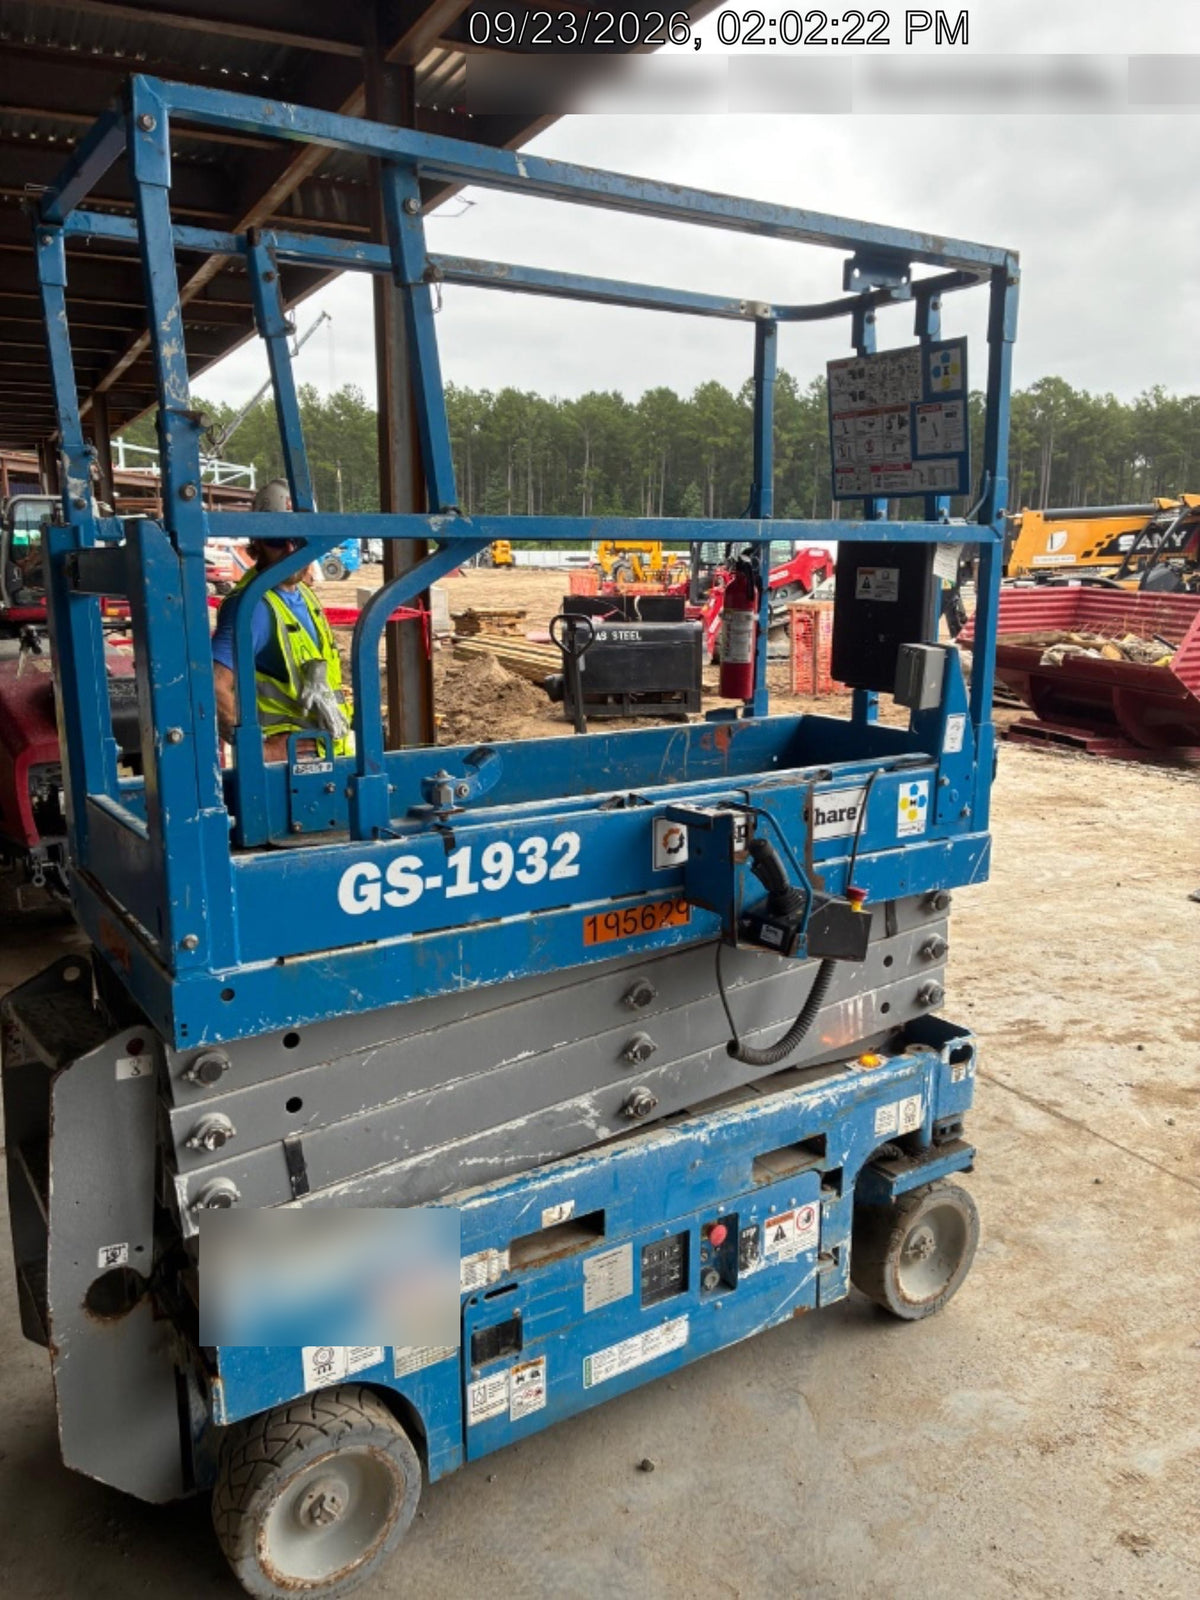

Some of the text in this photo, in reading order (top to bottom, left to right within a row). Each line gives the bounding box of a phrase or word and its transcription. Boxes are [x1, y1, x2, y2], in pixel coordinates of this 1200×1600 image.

[611, 630, 643, 641] STEEL
[337, 831, 580, 915] GS-1932
[587, 898, 690, 943] 195629
